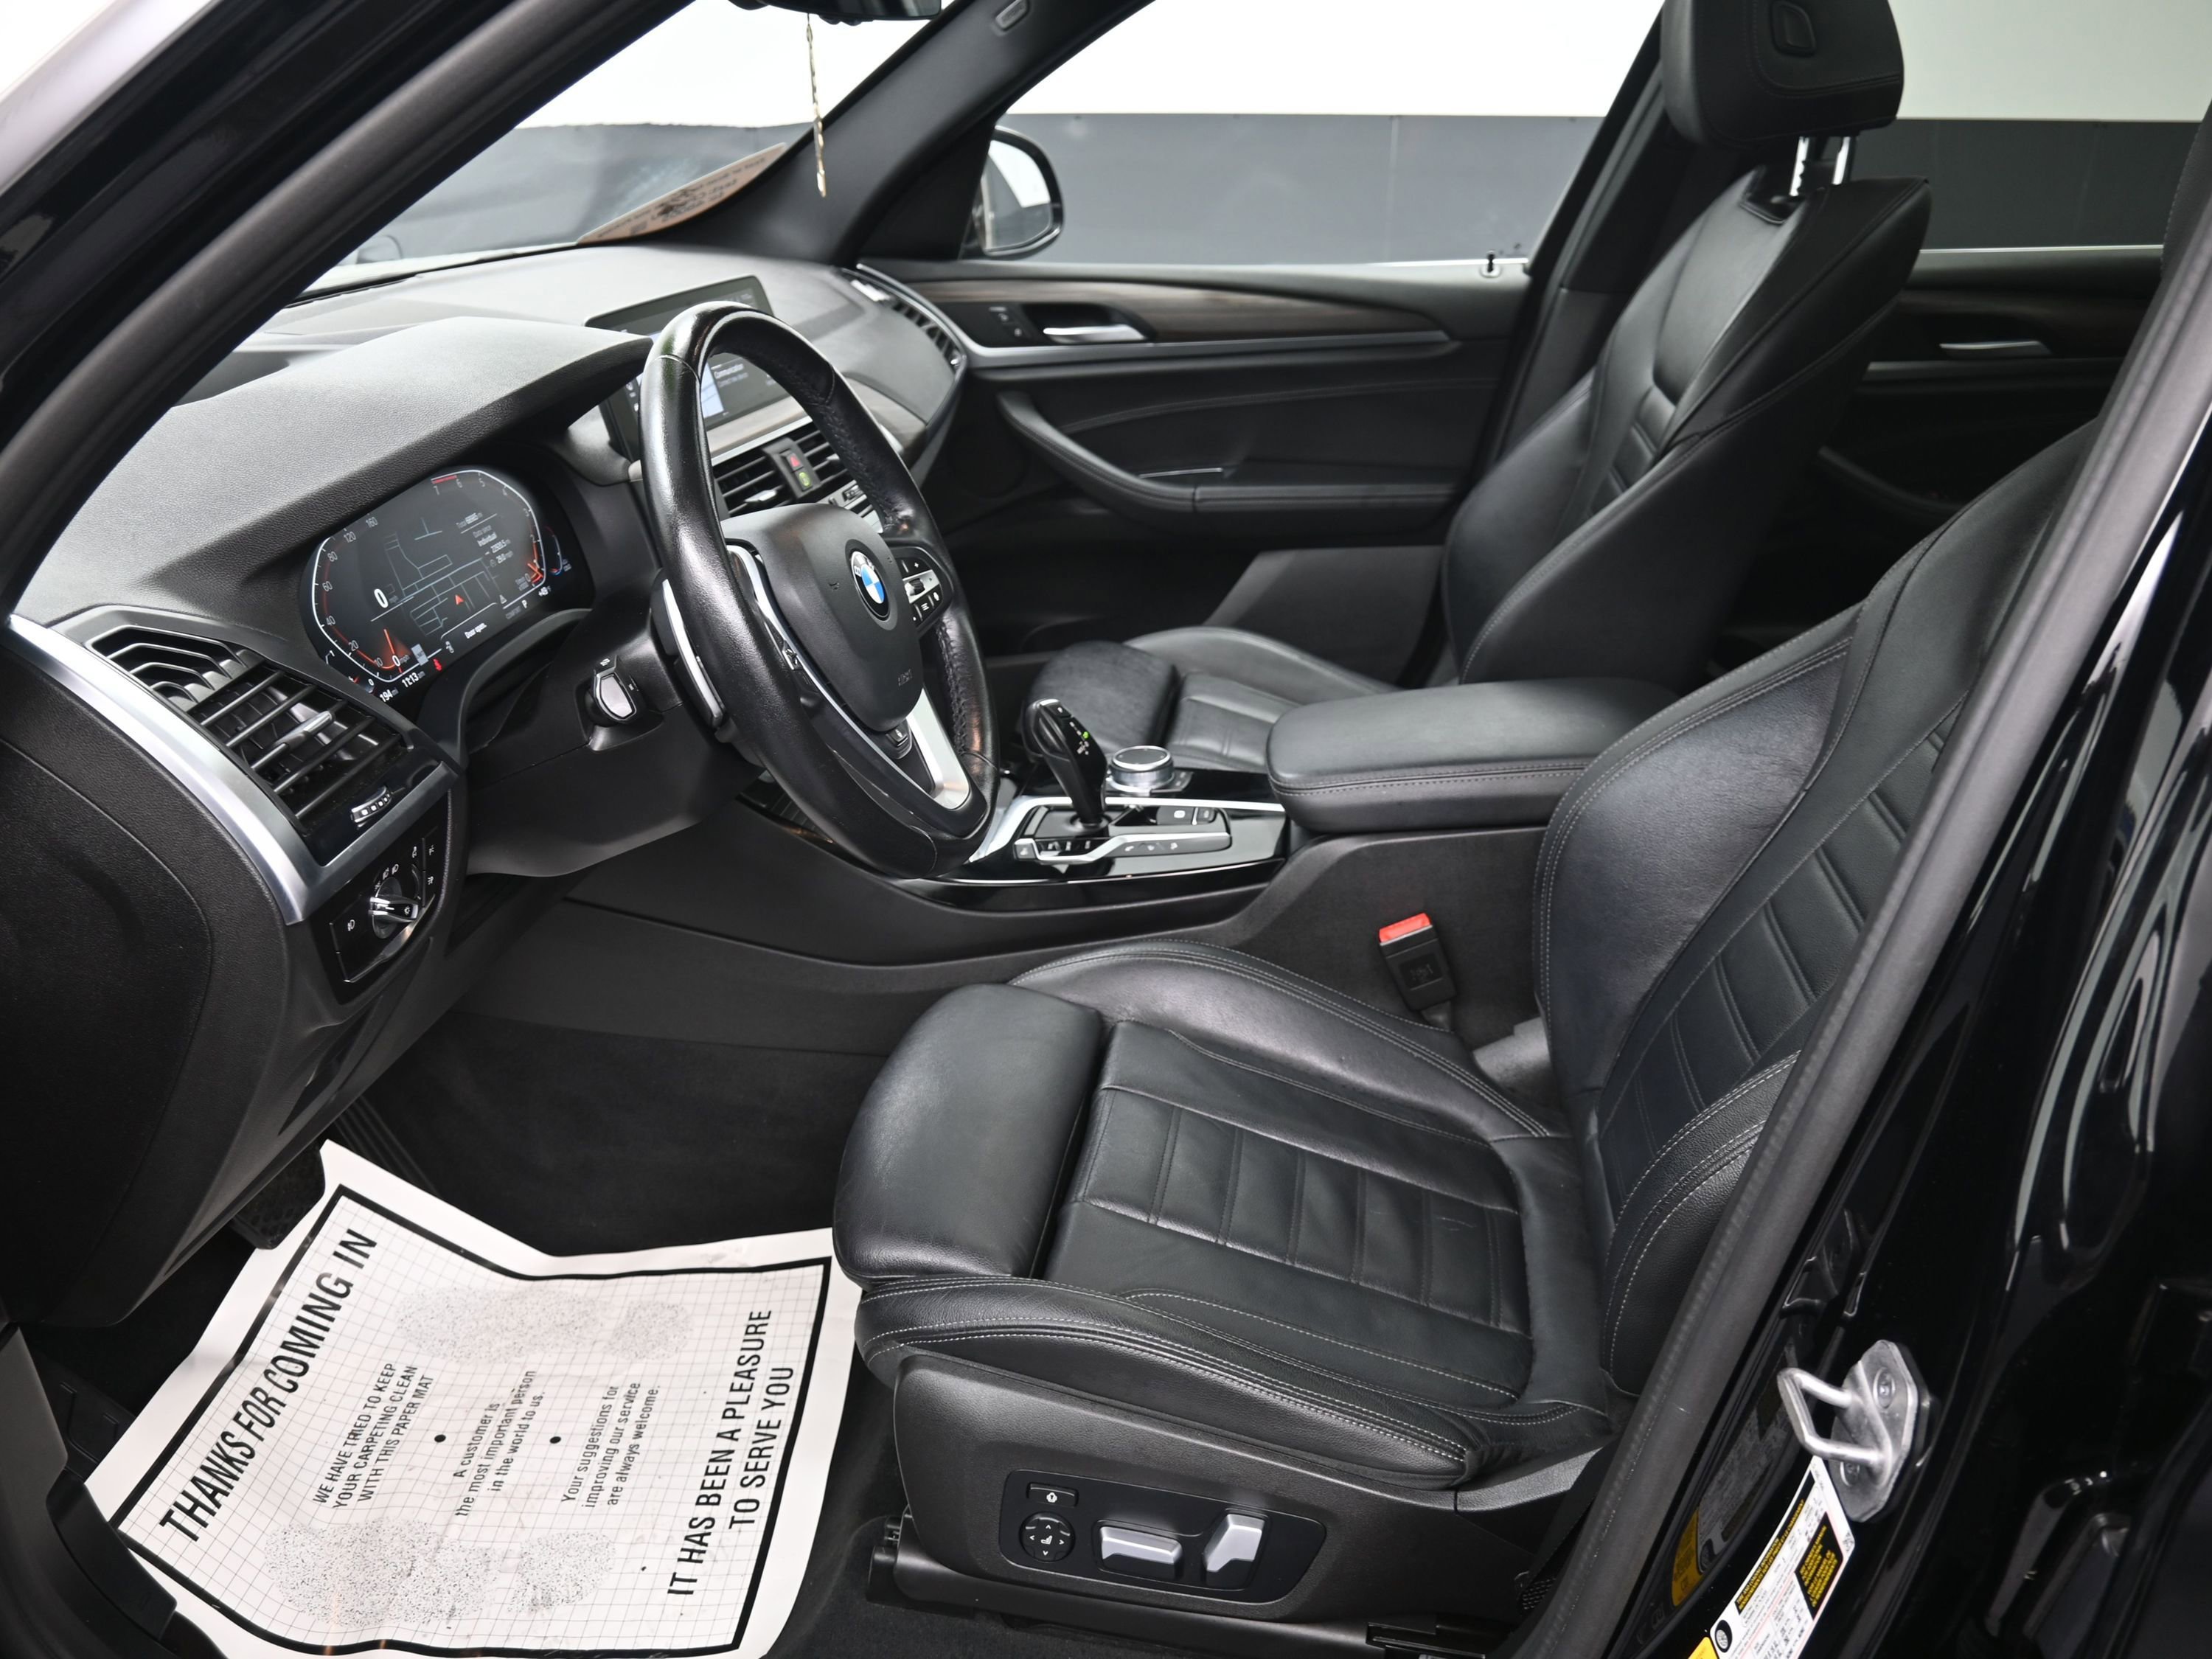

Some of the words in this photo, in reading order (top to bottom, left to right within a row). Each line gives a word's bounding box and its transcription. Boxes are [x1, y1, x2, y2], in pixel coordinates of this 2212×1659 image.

[366, 517, 378, 528] 160
[344, 531, 356, 543] 120
[327, 552, 338, 562] 80
[322, 581, 333, 592] 60
[374, 588, 389, 608] 0
[521, 599, 528, 608] P
[326, 616, 335, 626] 40
[348, 640, 359, 651] 20
[374, 657, 383, 668] 10
[392, 655, 401, 667] 0
[401, 672, 420, 687] 11:13
[380, 689, 393, 702] 194
[721, 1310, 771, 1419] PLEASURE
[159, 1431, 255, 1542] THANKS
[232, 1387, 287, 1441] FOR
[263, 1273, 353, 1393] COMING
[333, 1228, 378, 1269] IN
[761, 1368, 793, 1411] YOU
[529, 1391, 545, 1407] us.
[521, 1410, 536, 1422] to
[313, 1484, 335, 1503] WE
[325, 1451, 352, 1481] HAVE
[344, 1414, 371, 1447] TRIED
[363, 1396, 381, 1410] TO
[373, 1363, 396, 1392] KEEP
[333, 1475, 361, 1508] YOUR
[354, 1406, 397, 1469] CARPETING
[389, 1366, 417, 1402] CLEAN
[358, 1468, 384, 1501] WITH
[375, 1439, 400, 1464] THIS
[392, 1402, 420, 1436] PAPER
[412, 1375, 434, 1399] MAT
[453, 1469, 467, 1478] A
[461, 1415, 493, 1466] customer
[484, 1403, 500, 1412] is
[507, 1424, 529, 1454] world
[716, 1428, 741, 1441] A
[455, 1497, 474, 1517] the
[468, 1464, 490, 1492] most
[481, 1408, 517, 1459] important
[511, 1371, 537, 1405] person
[561, 1475, 584, 1502] Your
[577, 1404, 612, 1472] suggestions
[602, 1386, 619, 1399] for
[582, 1447, 619, 1508] improving
[610, 1427, 625, 1444] our
[618, 1382, 640, 1423] service
[608, 1486, 623, 1505] are
[616, 1444, 640, 1482] always
[633, 1385, 660, 1439] welcome.
[740, 1419, 782, 1487] SERVE
[495, 1458, 513, 1475] the
[487, 1480, 504, 1491] in
[695, 1450, 735, 1506] BEEN
[728, 1499, 759, 1529] TO
[677, 1517, 715, 1564] HAS
[667, 1572, 698, 1595] IT
